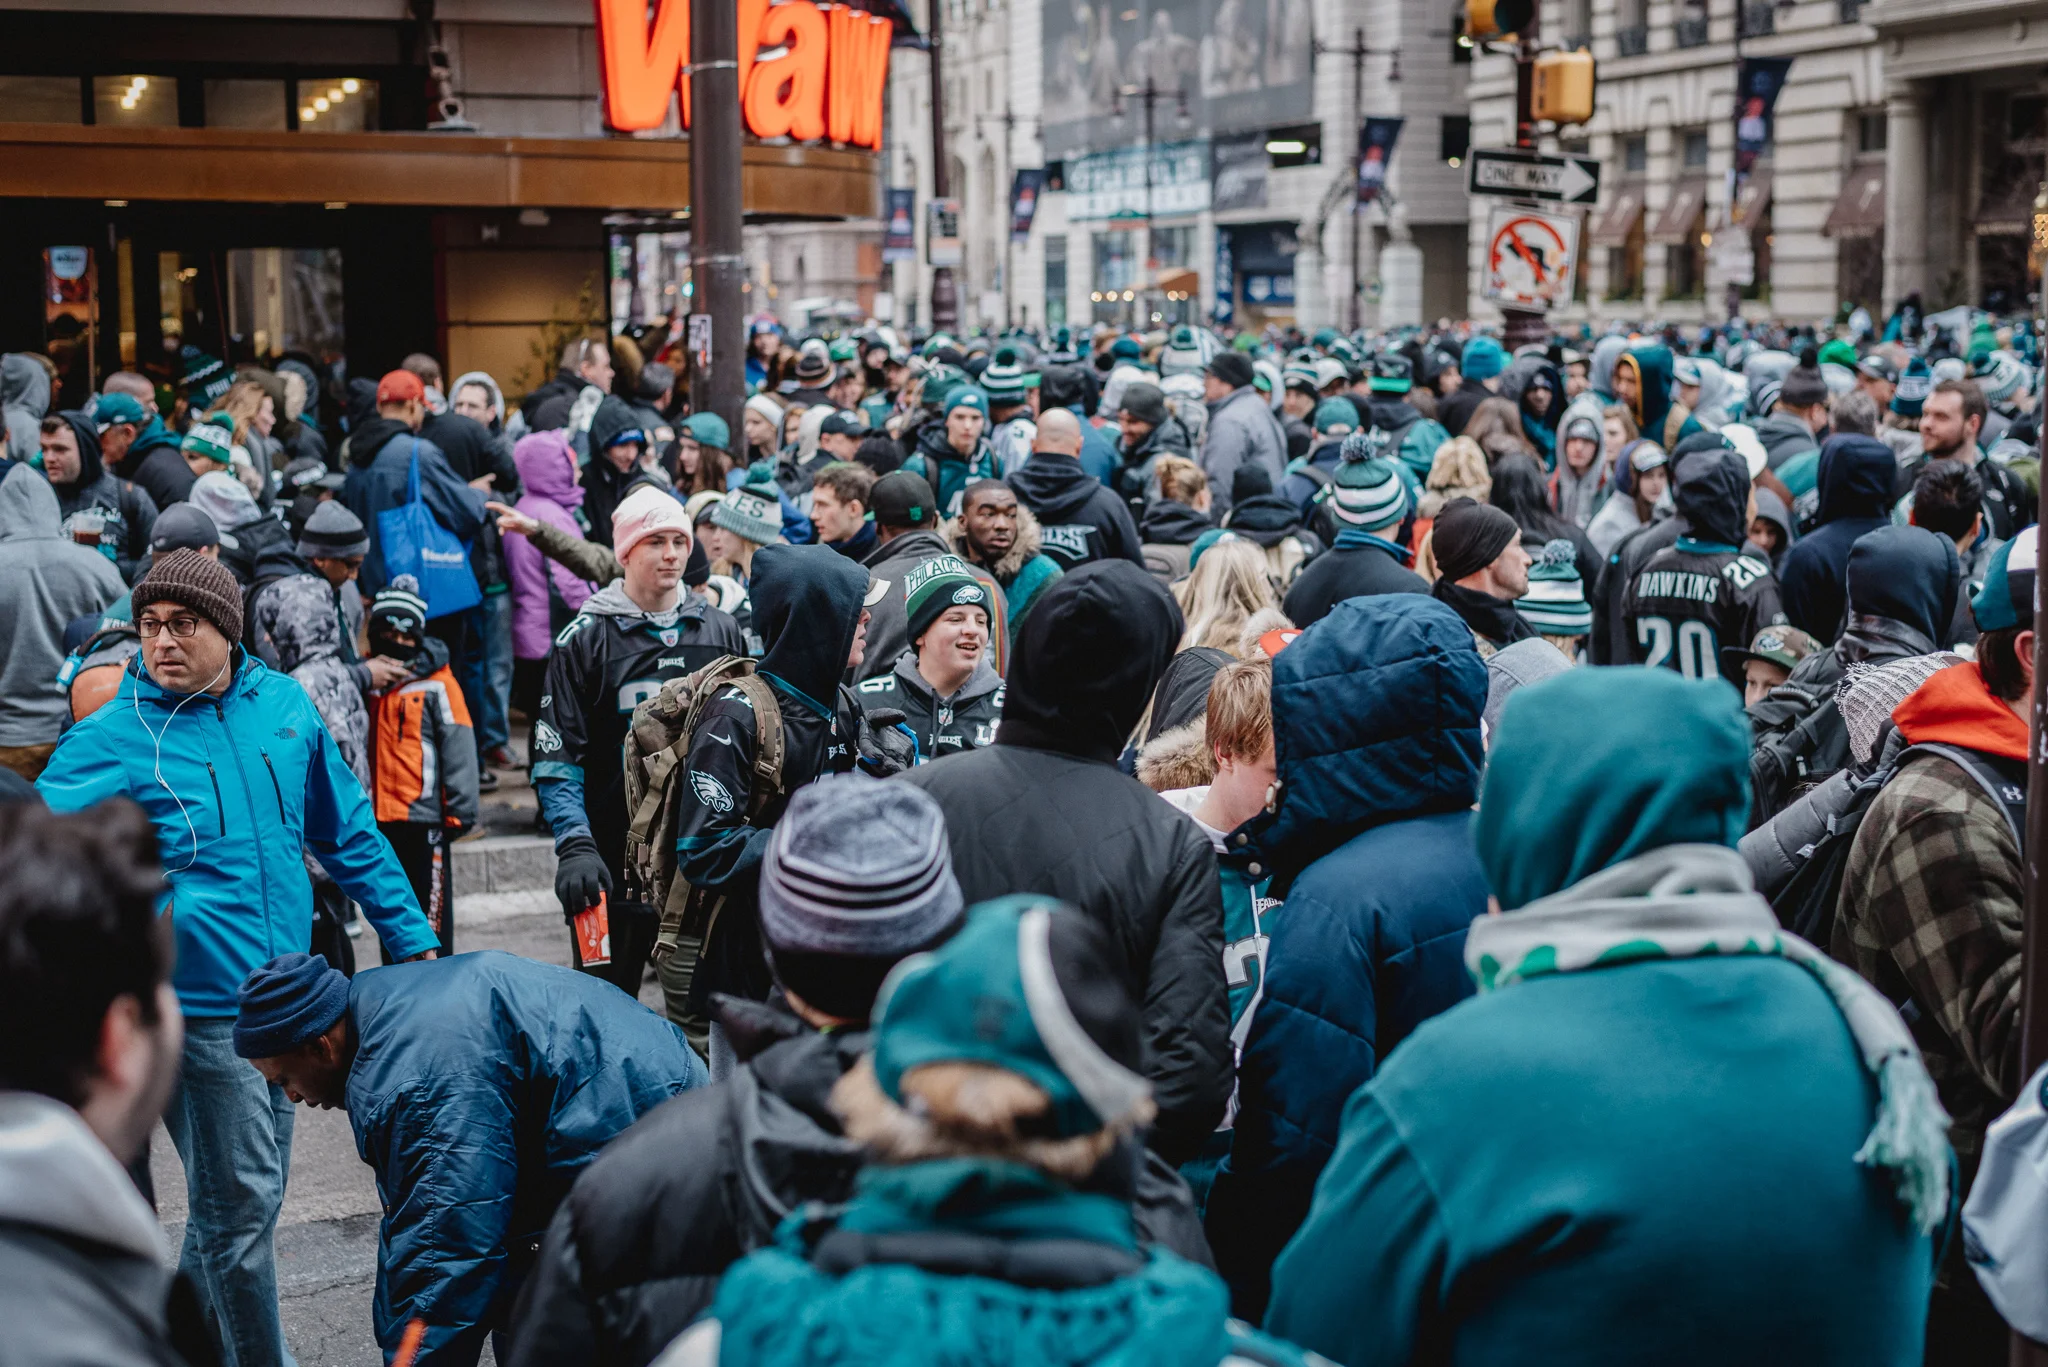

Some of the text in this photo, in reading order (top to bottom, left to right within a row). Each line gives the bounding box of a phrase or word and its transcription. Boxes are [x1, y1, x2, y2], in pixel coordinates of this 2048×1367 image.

[1483, 165, 1560, 185] ONE WAY
[1638, 571, 1720, 603] DAWKINS
[1721, 555, 1769, 590] 20
[657, 656, 685, 670] EAGLES
[1637, 617, 1719, 681] 20
